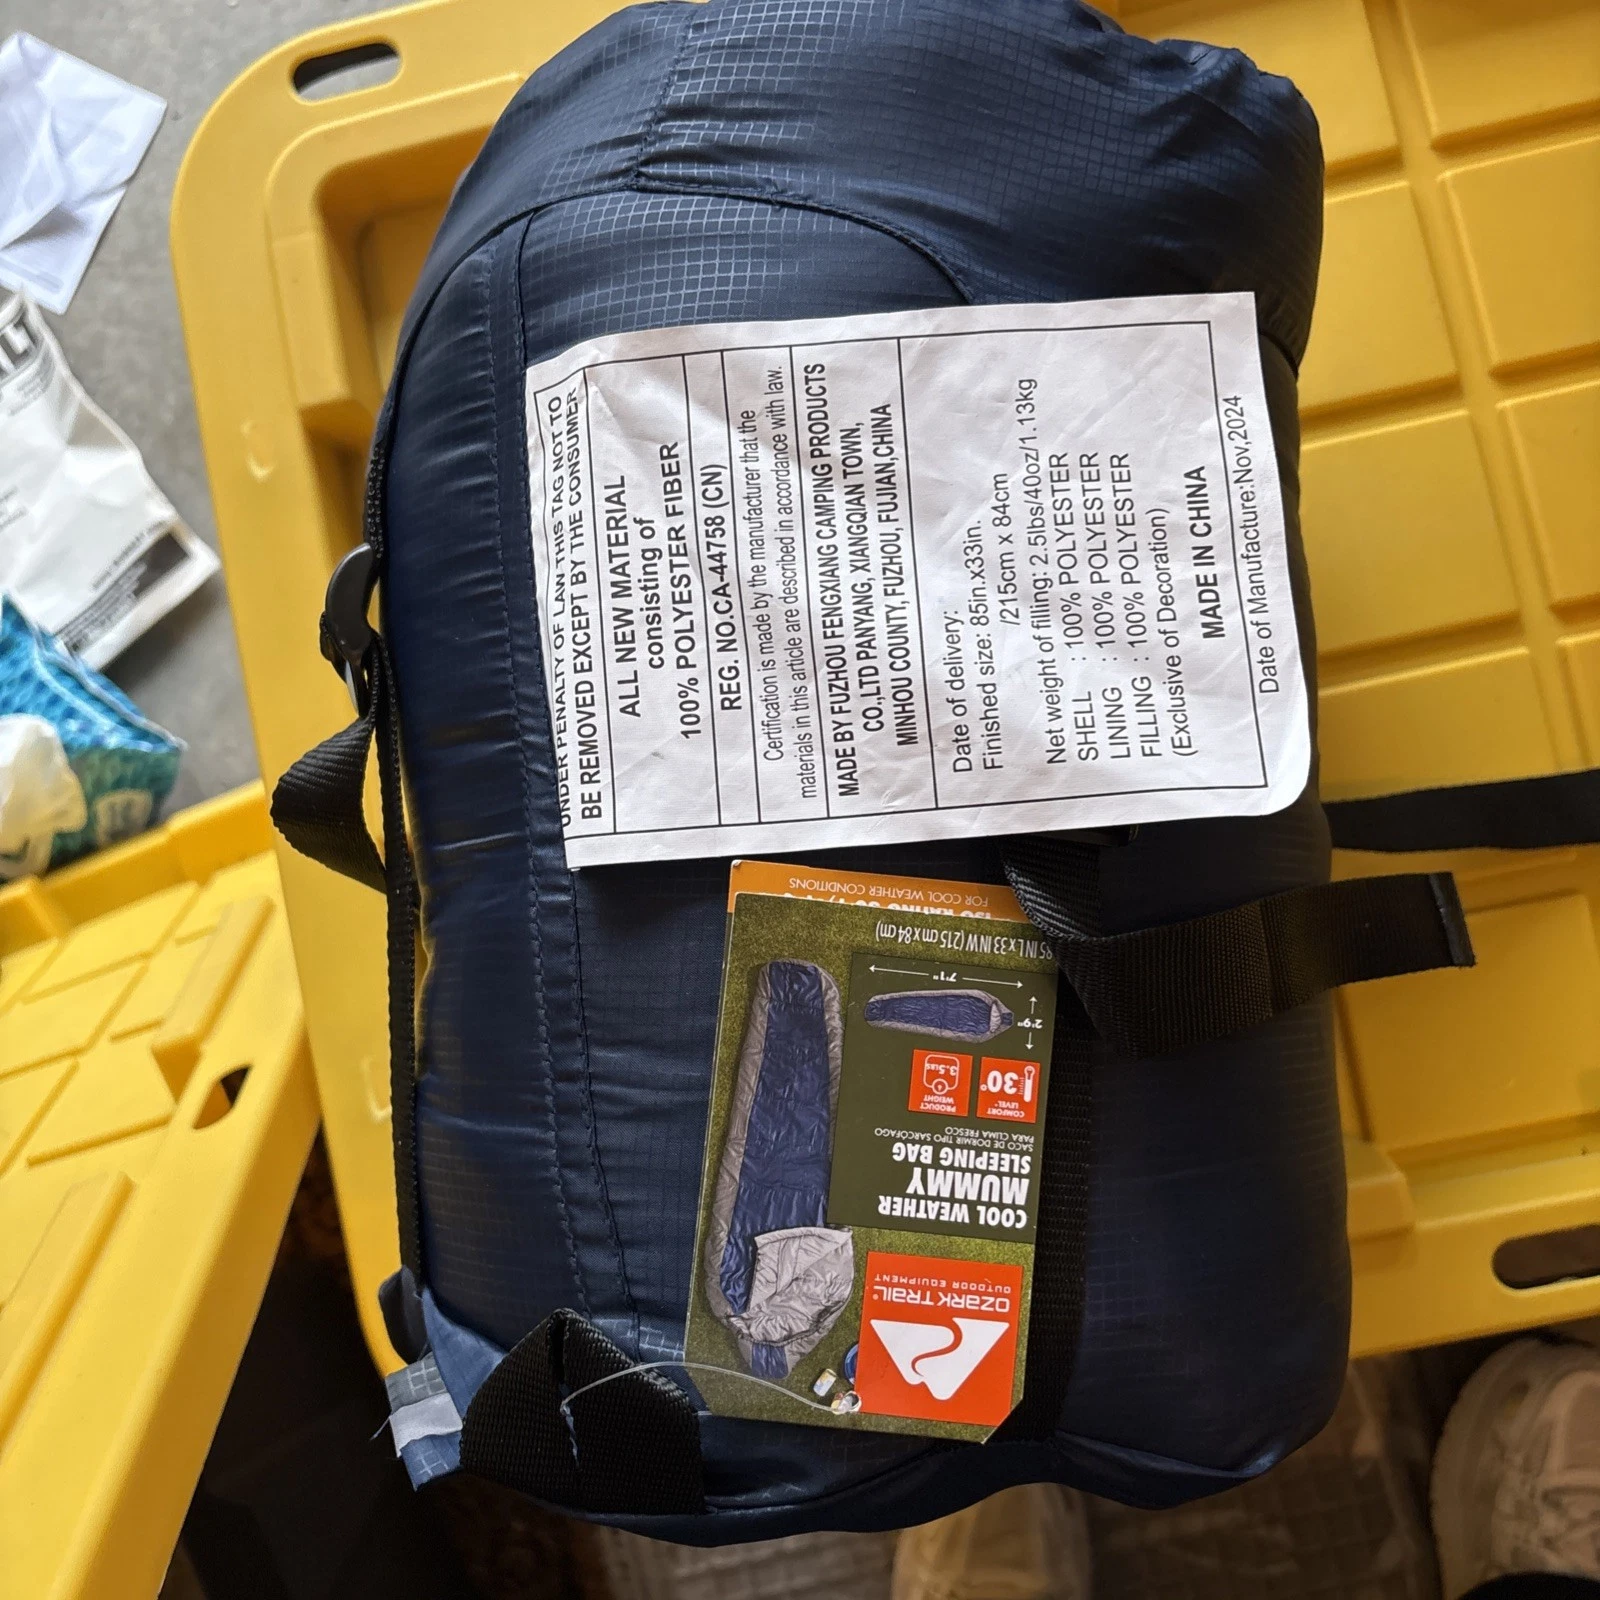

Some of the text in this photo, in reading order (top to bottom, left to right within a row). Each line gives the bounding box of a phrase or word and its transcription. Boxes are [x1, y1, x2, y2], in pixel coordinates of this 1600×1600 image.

[839, 423, 864, 480] TOWN,
[700, 464, 730, 508] (CN)
[843, 483, 871, 573] XIANGQIAN
[991, 473, 1020, 625] /215cm x 84cm
[1049, 453, 1079, 585] POLYESTER
[1079, 452, 1110, 584] POLYESTER
[1110, 453, 1141, 584] POLYESTER
[764, 366, 817, 798] materials in this article are described in accordance with law.
[803, 363, 860, 796] MADE BY FUZHOU FENGXIANG CAMPING PRODUCTS
[879, 528, 905, 597] FUZHOU,
[1015, 378, 1067, 764] Net weight of filling: 2.5lbs/40oz/1.13kg
[1183, 466, 1225, 639] MADE IN CHINA
[548, 396, 572, 827] UNDER PENALTY OF LAW THIS TAG NOT TO
[566, 388, 602, 819] BE REMOVED EXCEPT BY THE CONSUMER
[604, 475, 641, 718] ALL NEW MATERIAL
[633, 517, 665, 669] consisting of
[659, 441, 701, 739] 100% POLYESTER FIBER
[737, 410, 784, 761] Certification is made by the manufacturer that the
[851, 578, 878, 661] PANYANG,
[885, 601, 911, 672] COUNTY,
[1060, 592, 1084, 648] 100%
[1091, 591, 1116, 649] 100%
[1123, 592, 1147, 648] 100%
[1145, 508, 1198, 756] (Exclusive of Decoration)
[1250, 620, 1272, 639] of
[718, 660, 742, 711] REG.
[974, 634, 995, 675] size:
[1257, 646, 1279, 693] Date
[890, 677, 919, 746] MINHOU
[943, 611, 973, 773] Date of delivery:
[1102, 687, 1131, 759] LINING
[1131, 676, 1162, 757] FILLING
[976, 683, 1004, 770] Finished
[1072, 691, 1099, 761] SHELL
[789, 878, 866, 895] CONDITIONS
[869, 885, 924, 901] WEATHER
[928, 891, 961, 904] COOL
[965, 896, 987, 906] FOR
[898, 926, 912, 944] 84
[939, 930, 964, 951] (215
[993, 936, 1008, 955] 33
[920, 1102, 956, 1112] PRODUCT
[923, 1095, 954, 1104] WEIGHT
[987, 1108, 1025, 1118] COMFORT
[874, 1128, 1033, 1152] SACO DE DORMIR TIPO SARCÓFAGO
[892, 1142, 1031, 1174] SLEEPING BAG
[945, 1126, 1034, 1143] PARA CLIMA FRESCO
[878, 1195, 1027, 1229] COOL WEATHER
[906, 1167, 1030, 1206] MUMMY
[874, 1274, 1011, 1294] OUTDOOR EQUIPMENT
